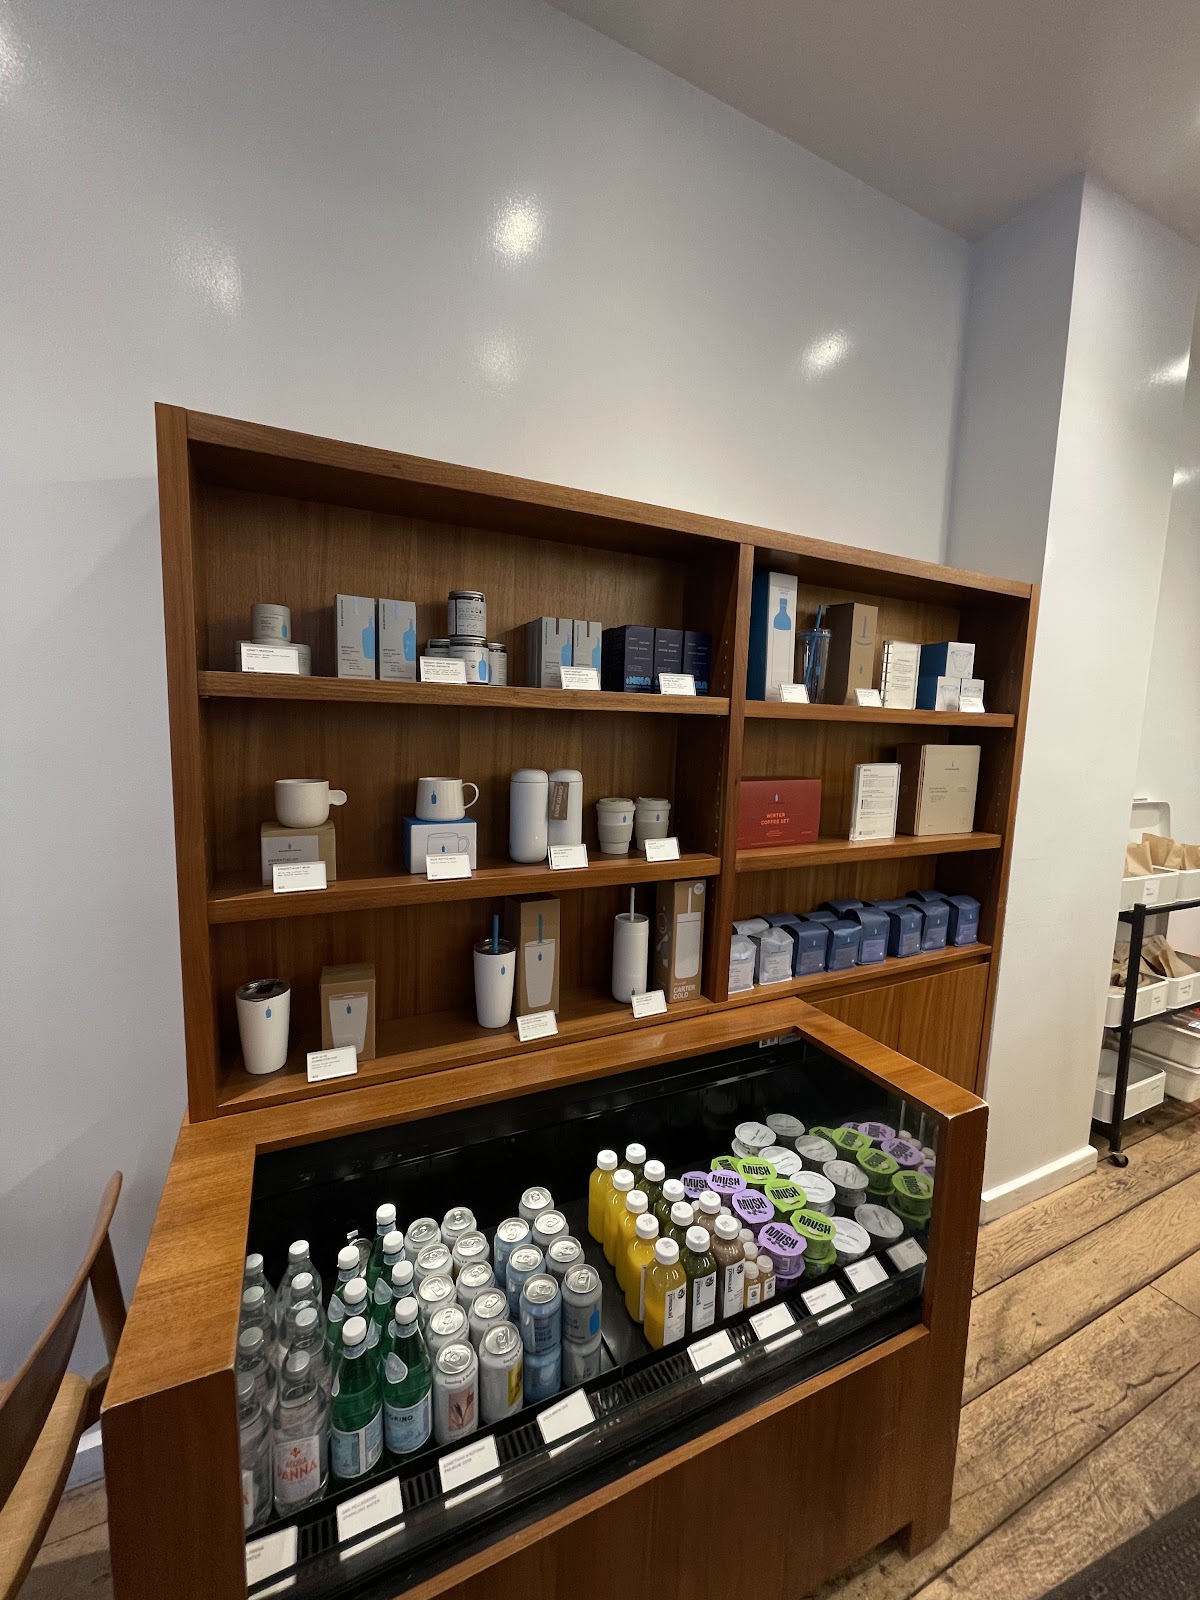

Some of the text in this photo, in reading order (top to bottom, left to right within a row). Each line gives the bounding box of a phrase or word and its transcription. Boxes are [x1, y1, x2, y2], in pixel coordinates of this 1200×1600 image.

[673, 984, 696, 994] CARTER
[673, 992, 689, 1000] COLD
[742, 1164, 771, 1176] MUSH
[712, 1174, 741, 1186] MUSH
[769, 1186, 801, 1200] MUSH
[737, 1197, 767, 1211] MUSH
[799, 1215, 831, 1235] MUSH
[764, 1225, 799, 1249] MUSH
